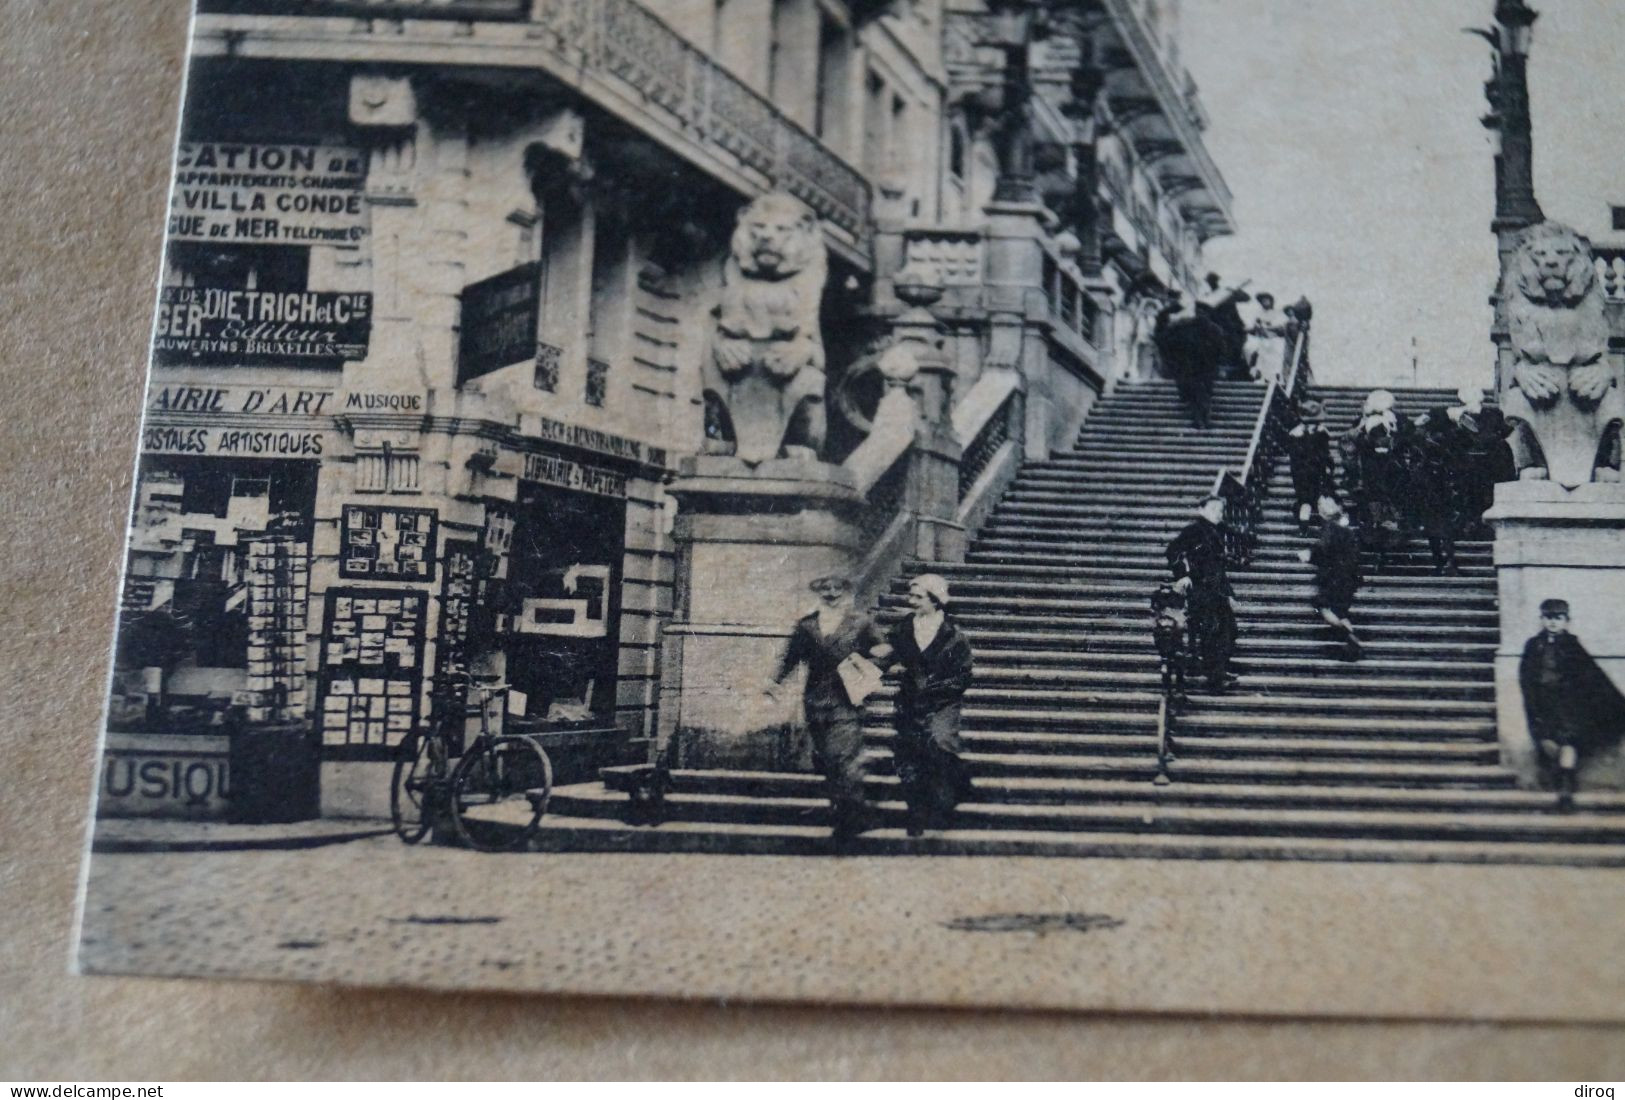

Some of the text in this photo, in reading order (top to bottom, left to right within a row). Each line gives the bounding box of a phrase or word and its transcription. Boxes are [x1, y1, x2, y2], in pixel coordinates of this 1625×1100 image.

[183, 189, 267, 213] VILLA
[209, 222, 231, 237] DE
[235, 217, 279, 239] MER
[201, 287, 318, 324] DIETRICH
[316, 301, 334, 324] et
[242, 389, 334, 415] D'ART
[346, 391, 422, 410] MUSIQUE
[217, 430, 323, 456] ARTISTIQUES
